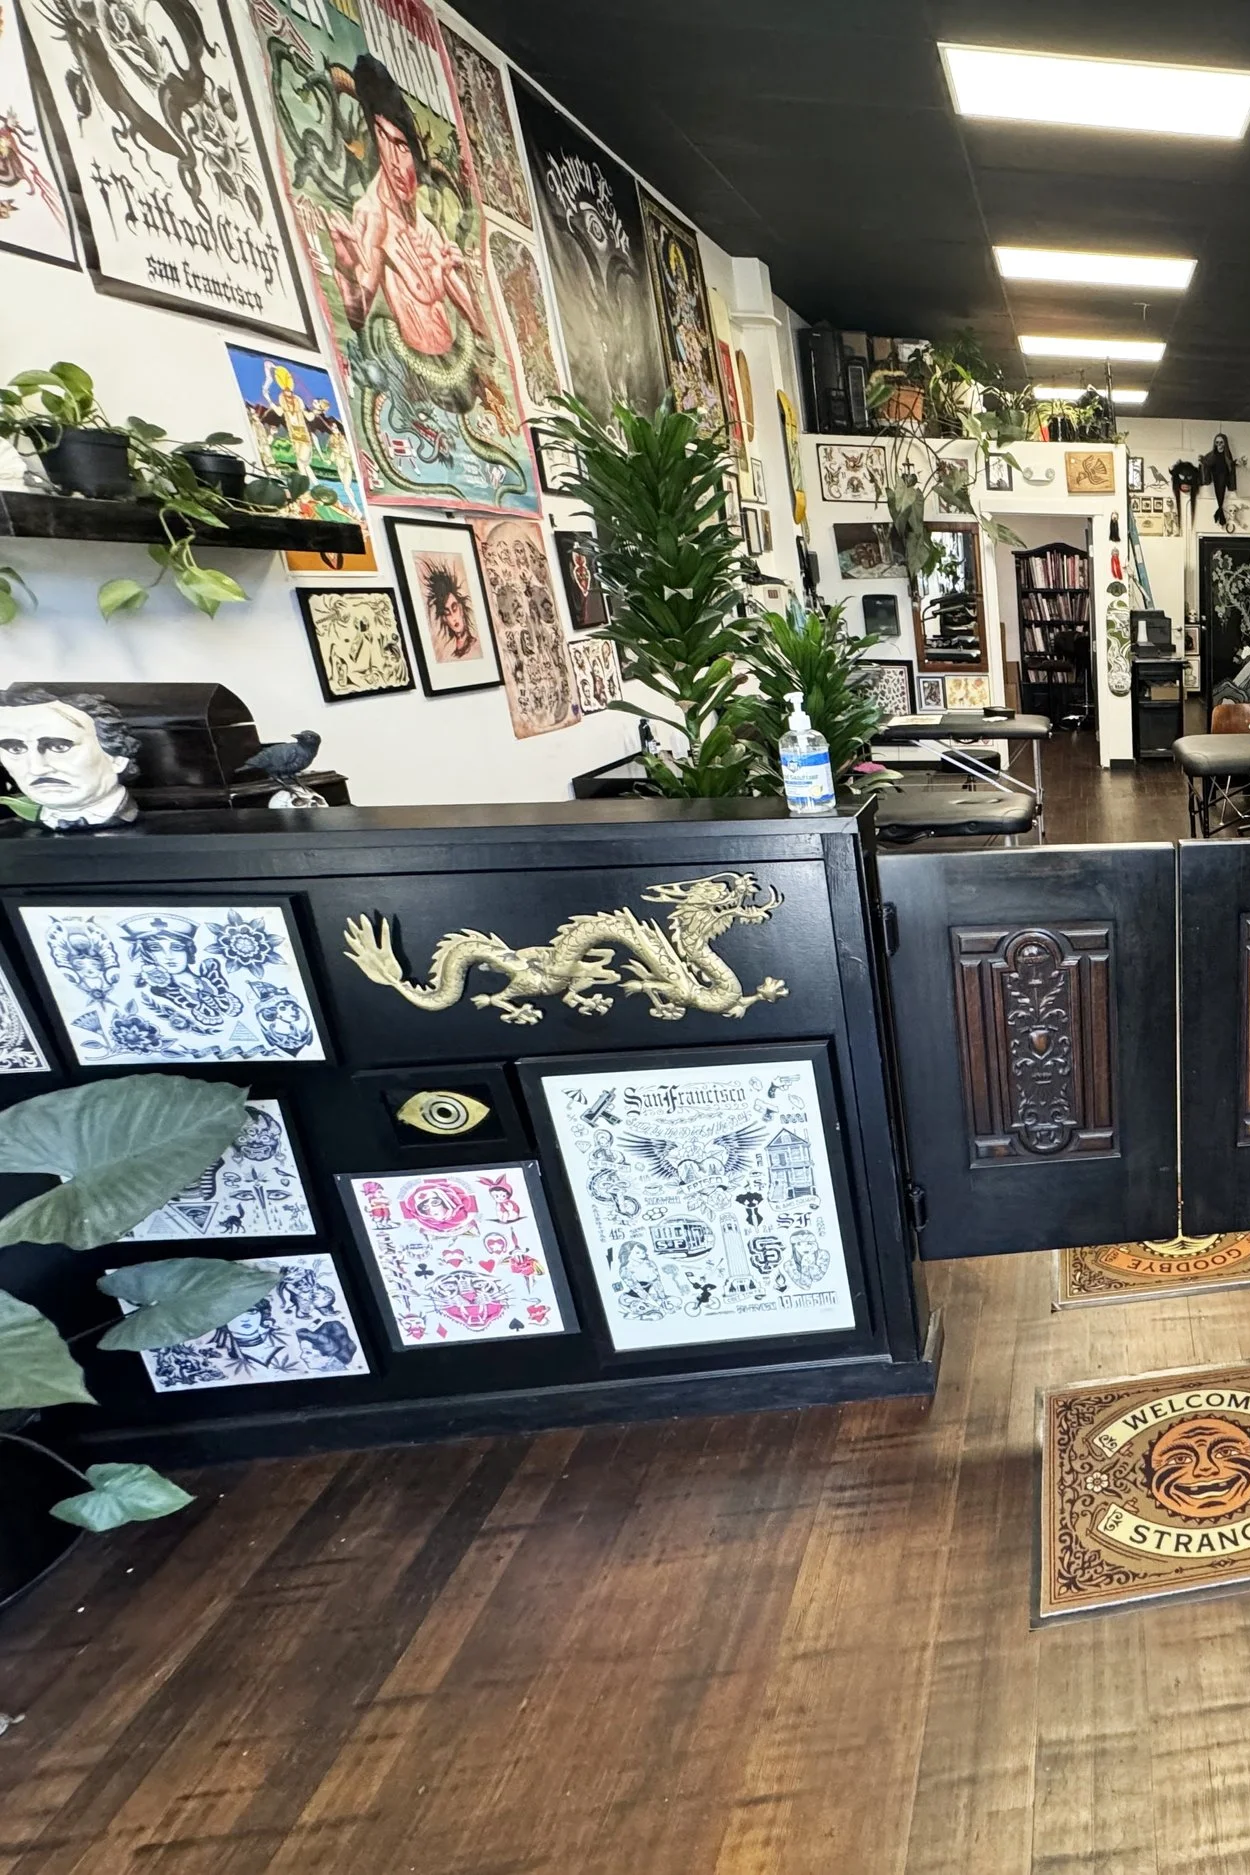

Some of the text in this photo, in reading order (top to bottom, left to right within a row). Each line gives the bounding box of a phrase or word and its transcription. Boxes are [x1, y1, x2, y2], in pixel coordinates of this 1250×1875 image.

[545, 149, 597, 213] Raven
[108, 164, 274, 295] Tattoo City
[145, 253, 264, 316] san francisco
[623, 1084, 747, 1116] San Francisco
[686, 1176, 723, 1192] FRISCO
[609, 1227, 626, 1240] 415
[776, 1213, 813, 1229] SF
[1126, 1247, 1242, 1273] GOODBYE
